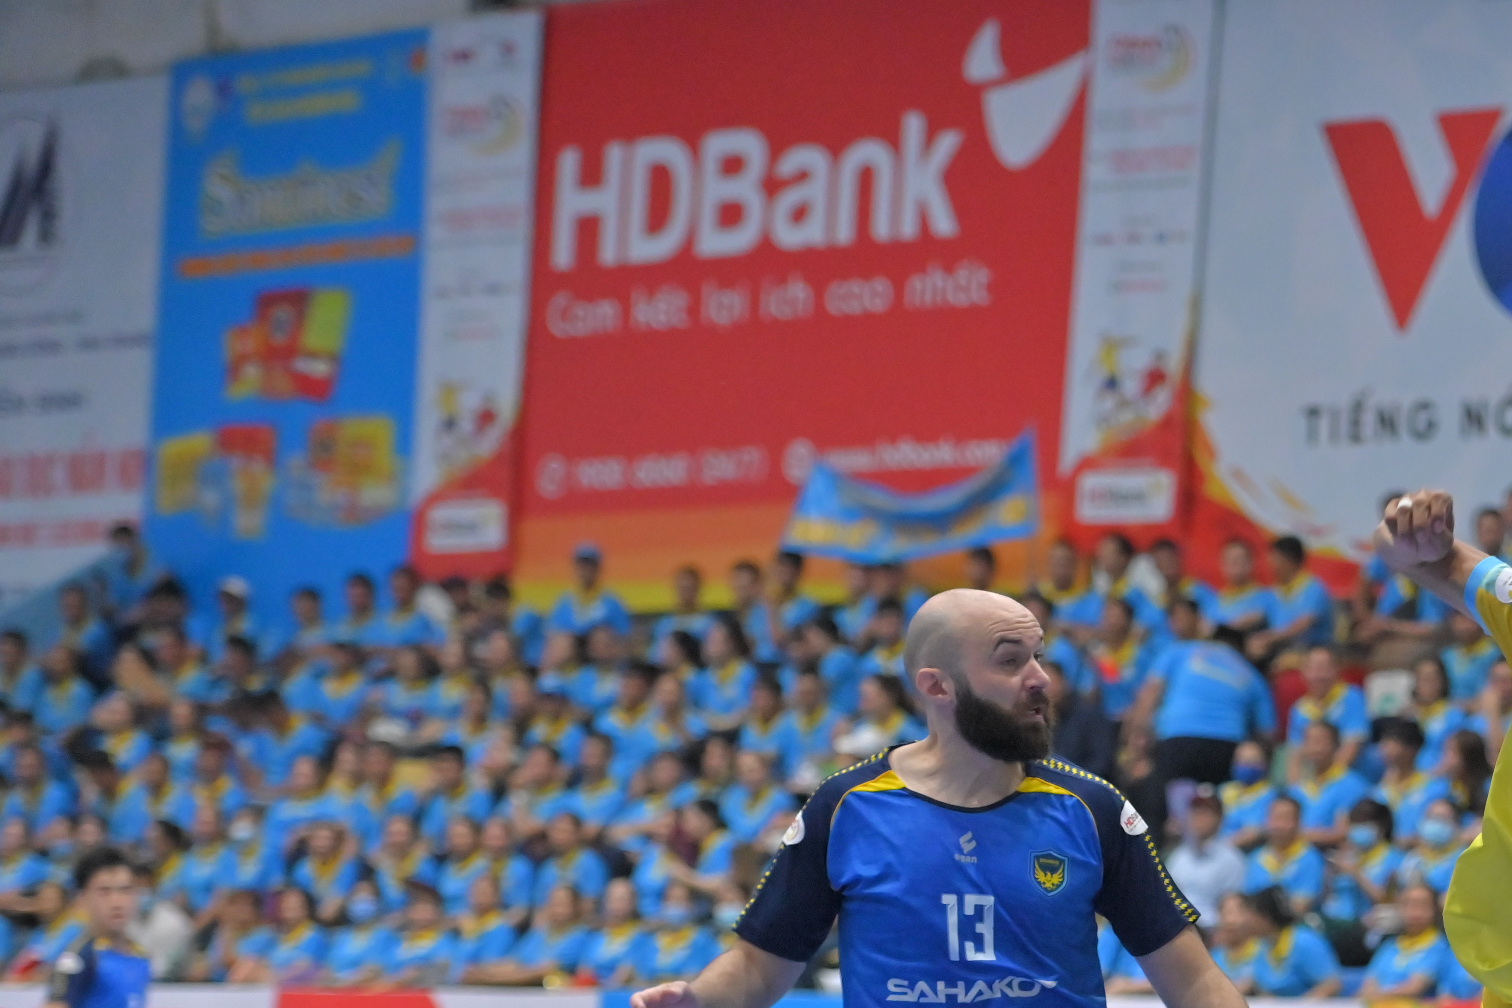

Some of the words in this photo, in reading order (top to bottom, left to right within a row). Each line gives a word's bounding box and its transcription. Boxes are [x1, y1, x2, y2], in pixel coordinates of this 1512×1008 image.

[550, 111, 965, 271] HDBank
[1302, 386, 1438, 447] TIẾNG
[942, 893, 997, 961] 13
[885, 974, 1056, 1004] SAHAKO
